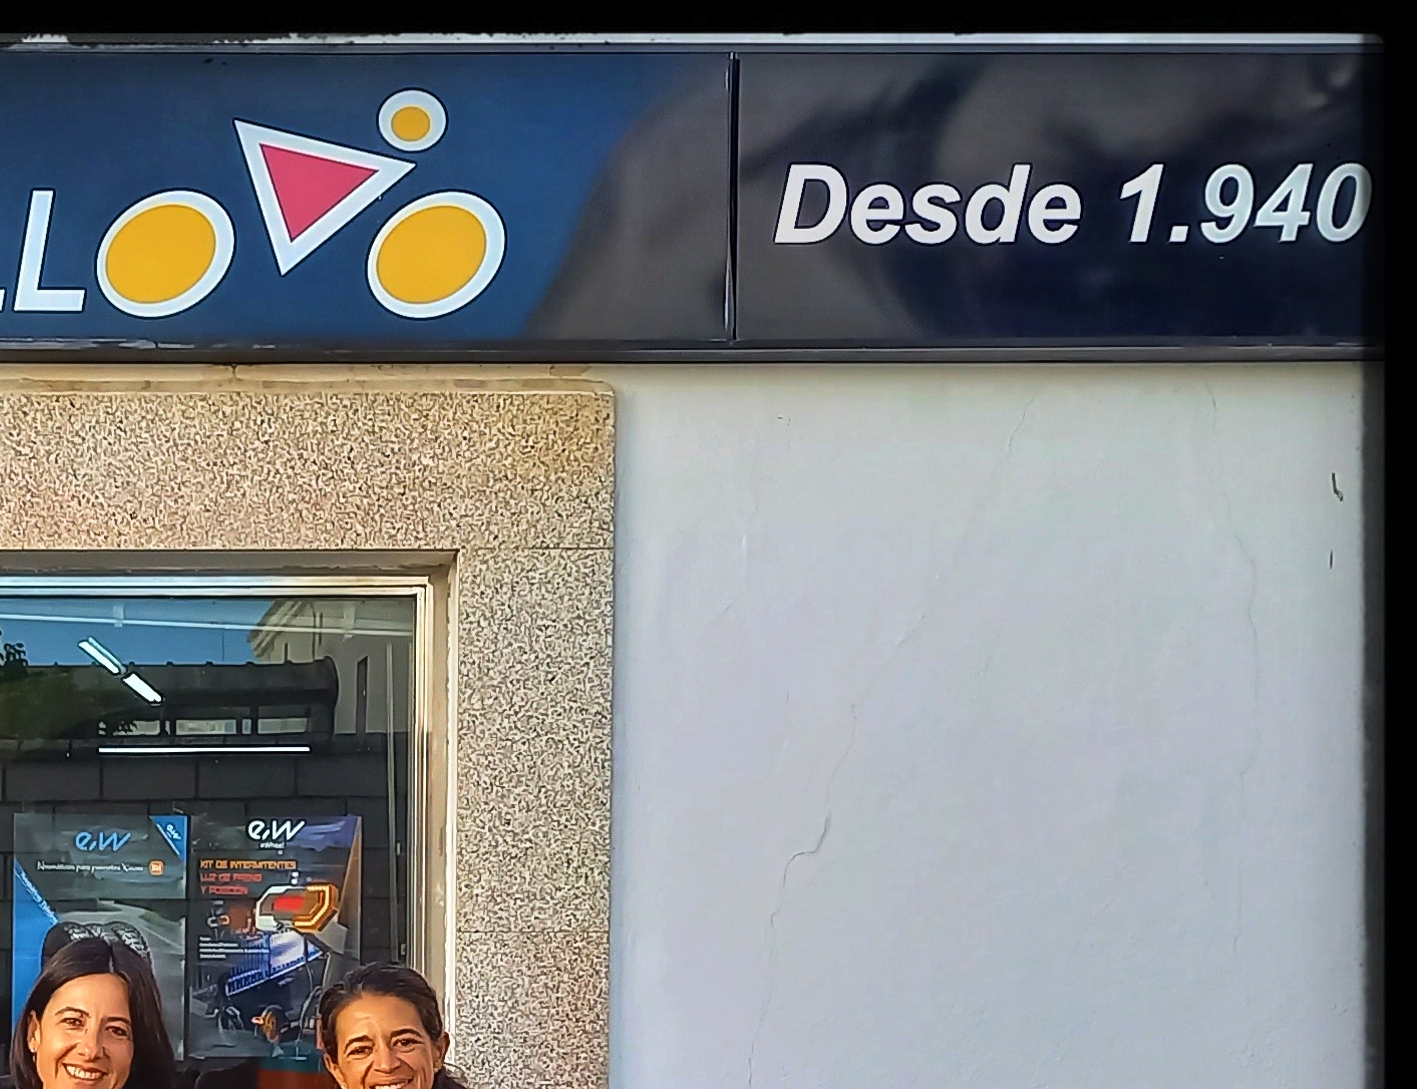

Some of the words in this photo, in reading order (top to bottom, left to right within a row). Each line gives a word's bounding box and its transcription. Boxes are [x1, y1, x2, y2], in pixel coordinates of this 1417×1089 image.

[773, 162, 1082, 245] Desde
[1118, 162, 1373, 244] 1.940
[215, 859, 228, 870] DE
